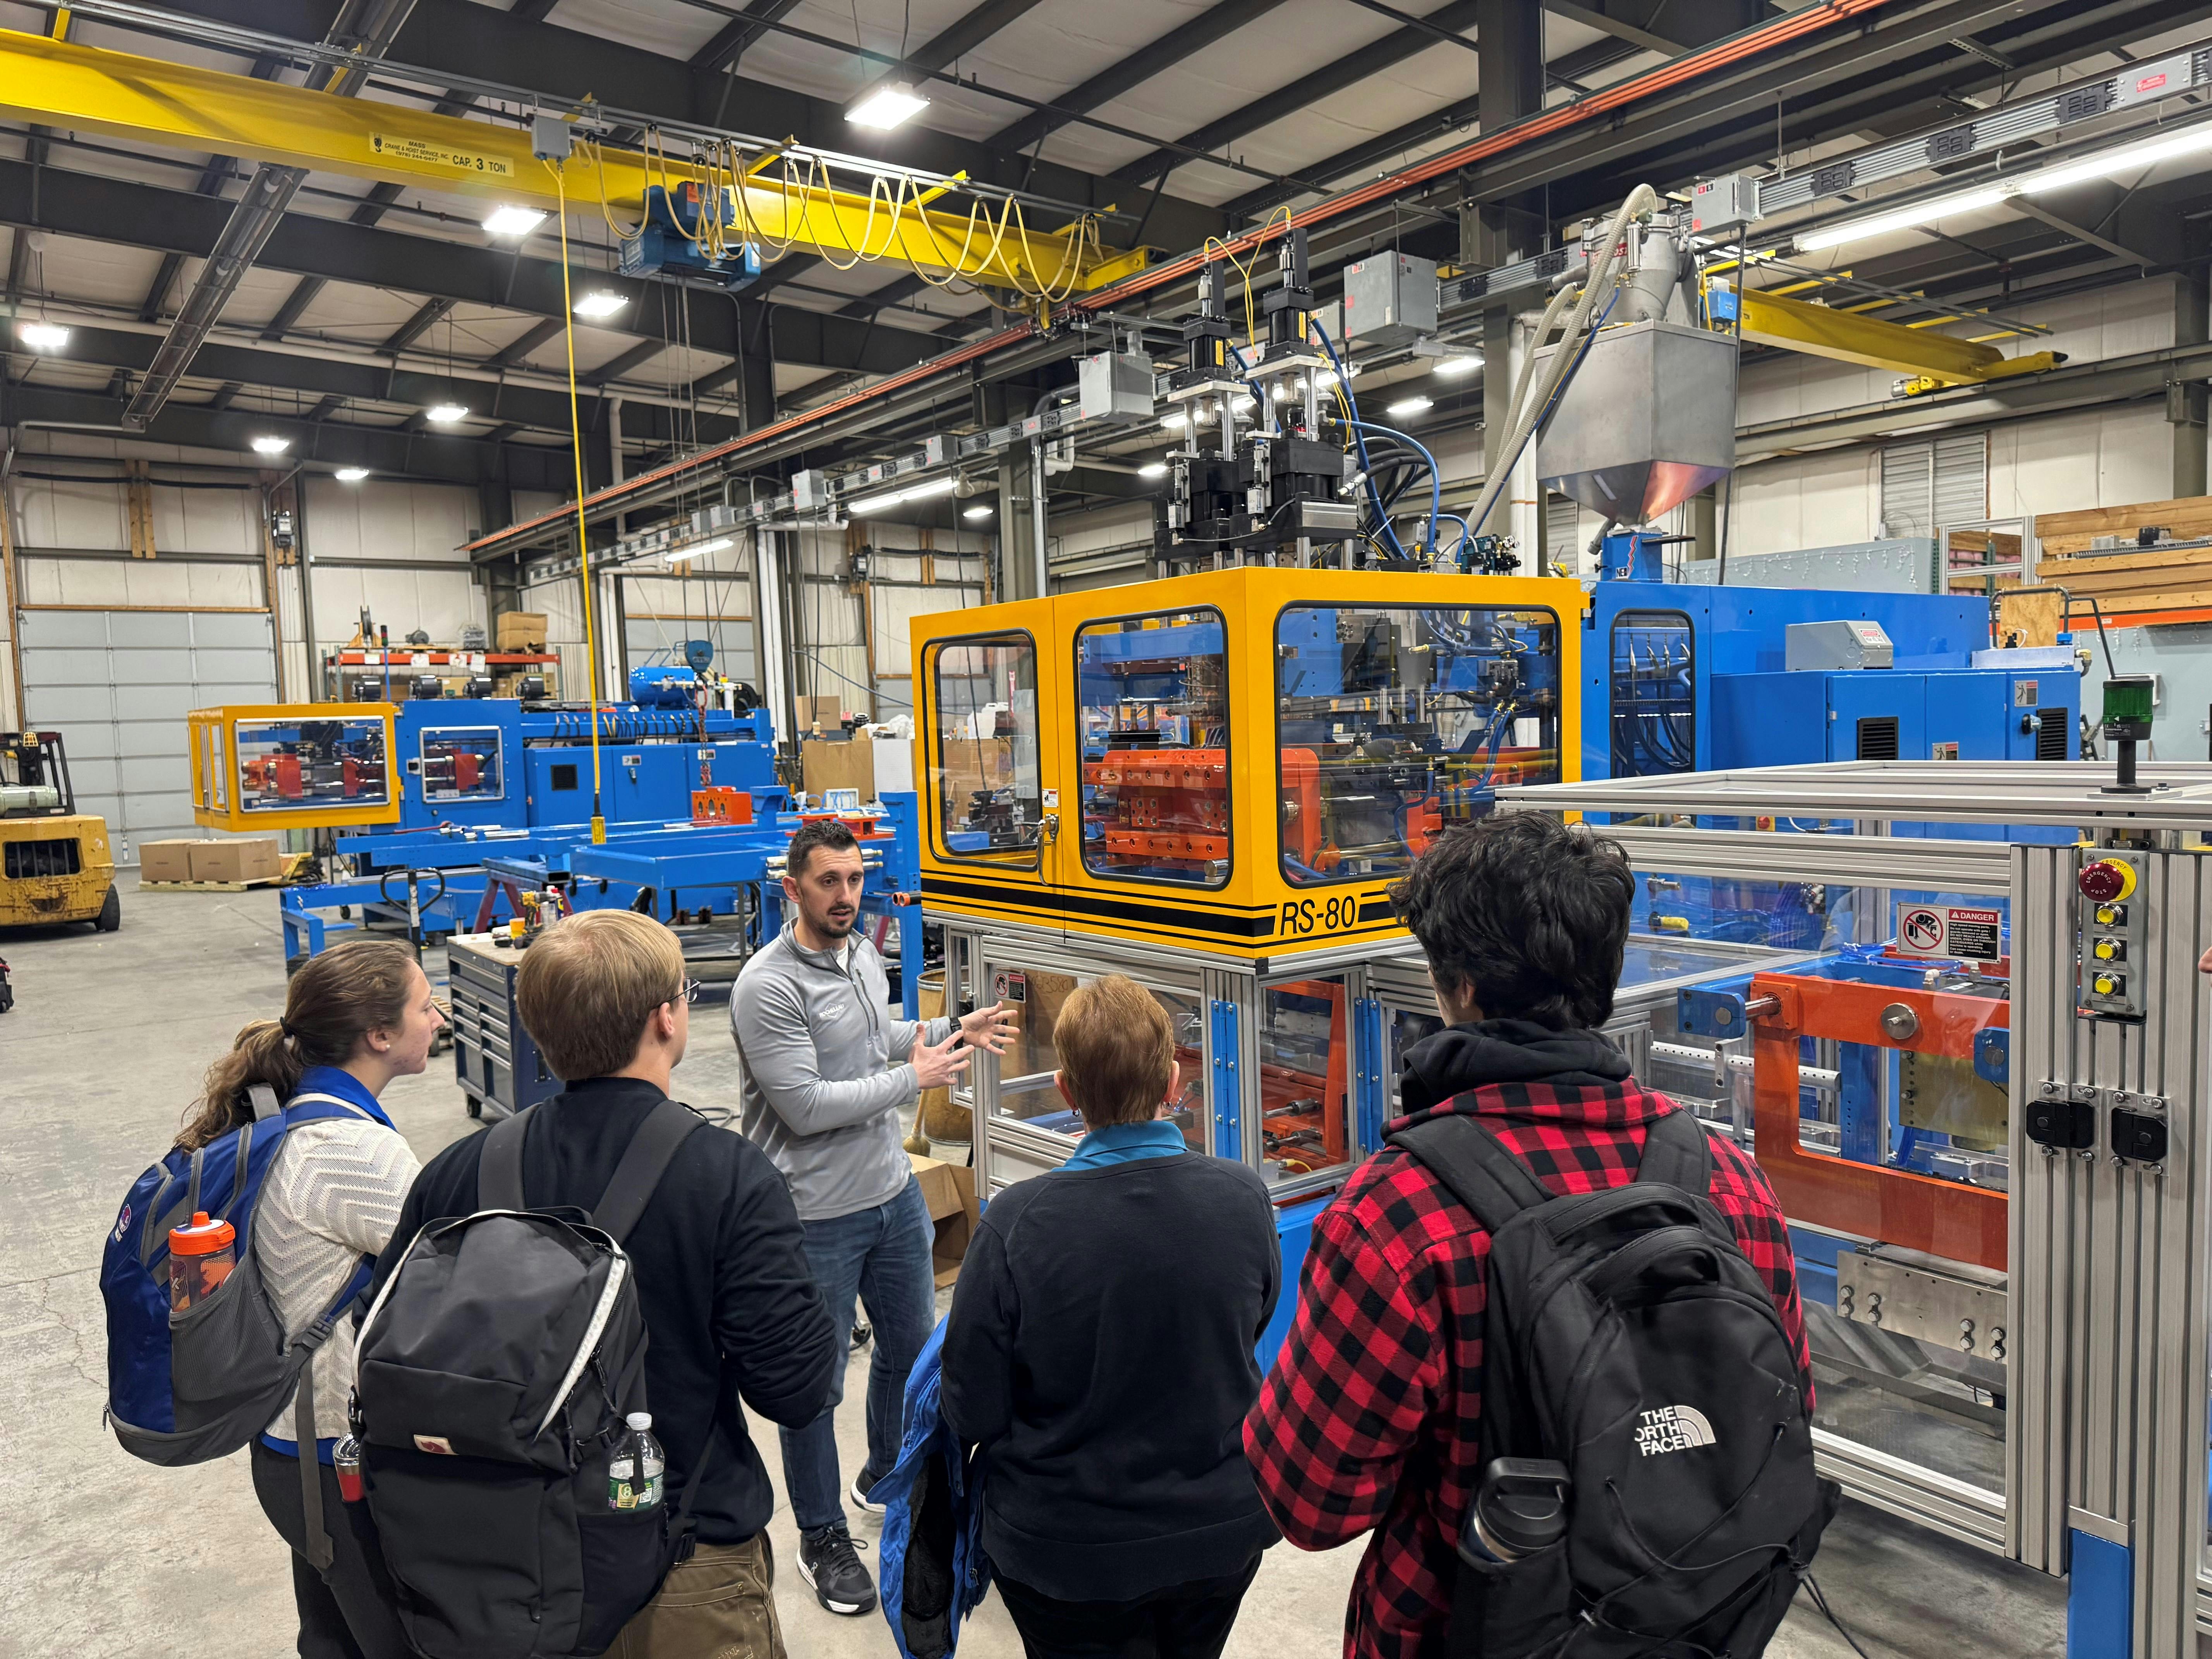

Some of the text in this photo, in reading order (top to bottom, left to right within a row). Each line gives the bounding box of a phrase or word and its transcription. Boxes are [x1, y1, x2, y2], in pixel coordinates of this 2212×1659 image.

[385, 143, 400, 151] CRANE
[453, 155, 506, 173] CAP. 3 TON
[2086, 871, 2112, 884] EMERGENCY
[1280, 896, 1355, 936] RS-80
[1960, 912, 1994, 921] DANGER
[1640, 1406, 1676, 1425] THE
[1635, 1420, 1681, 1442] ORTH
[1640, 1434, 1685, 1456] FACE
